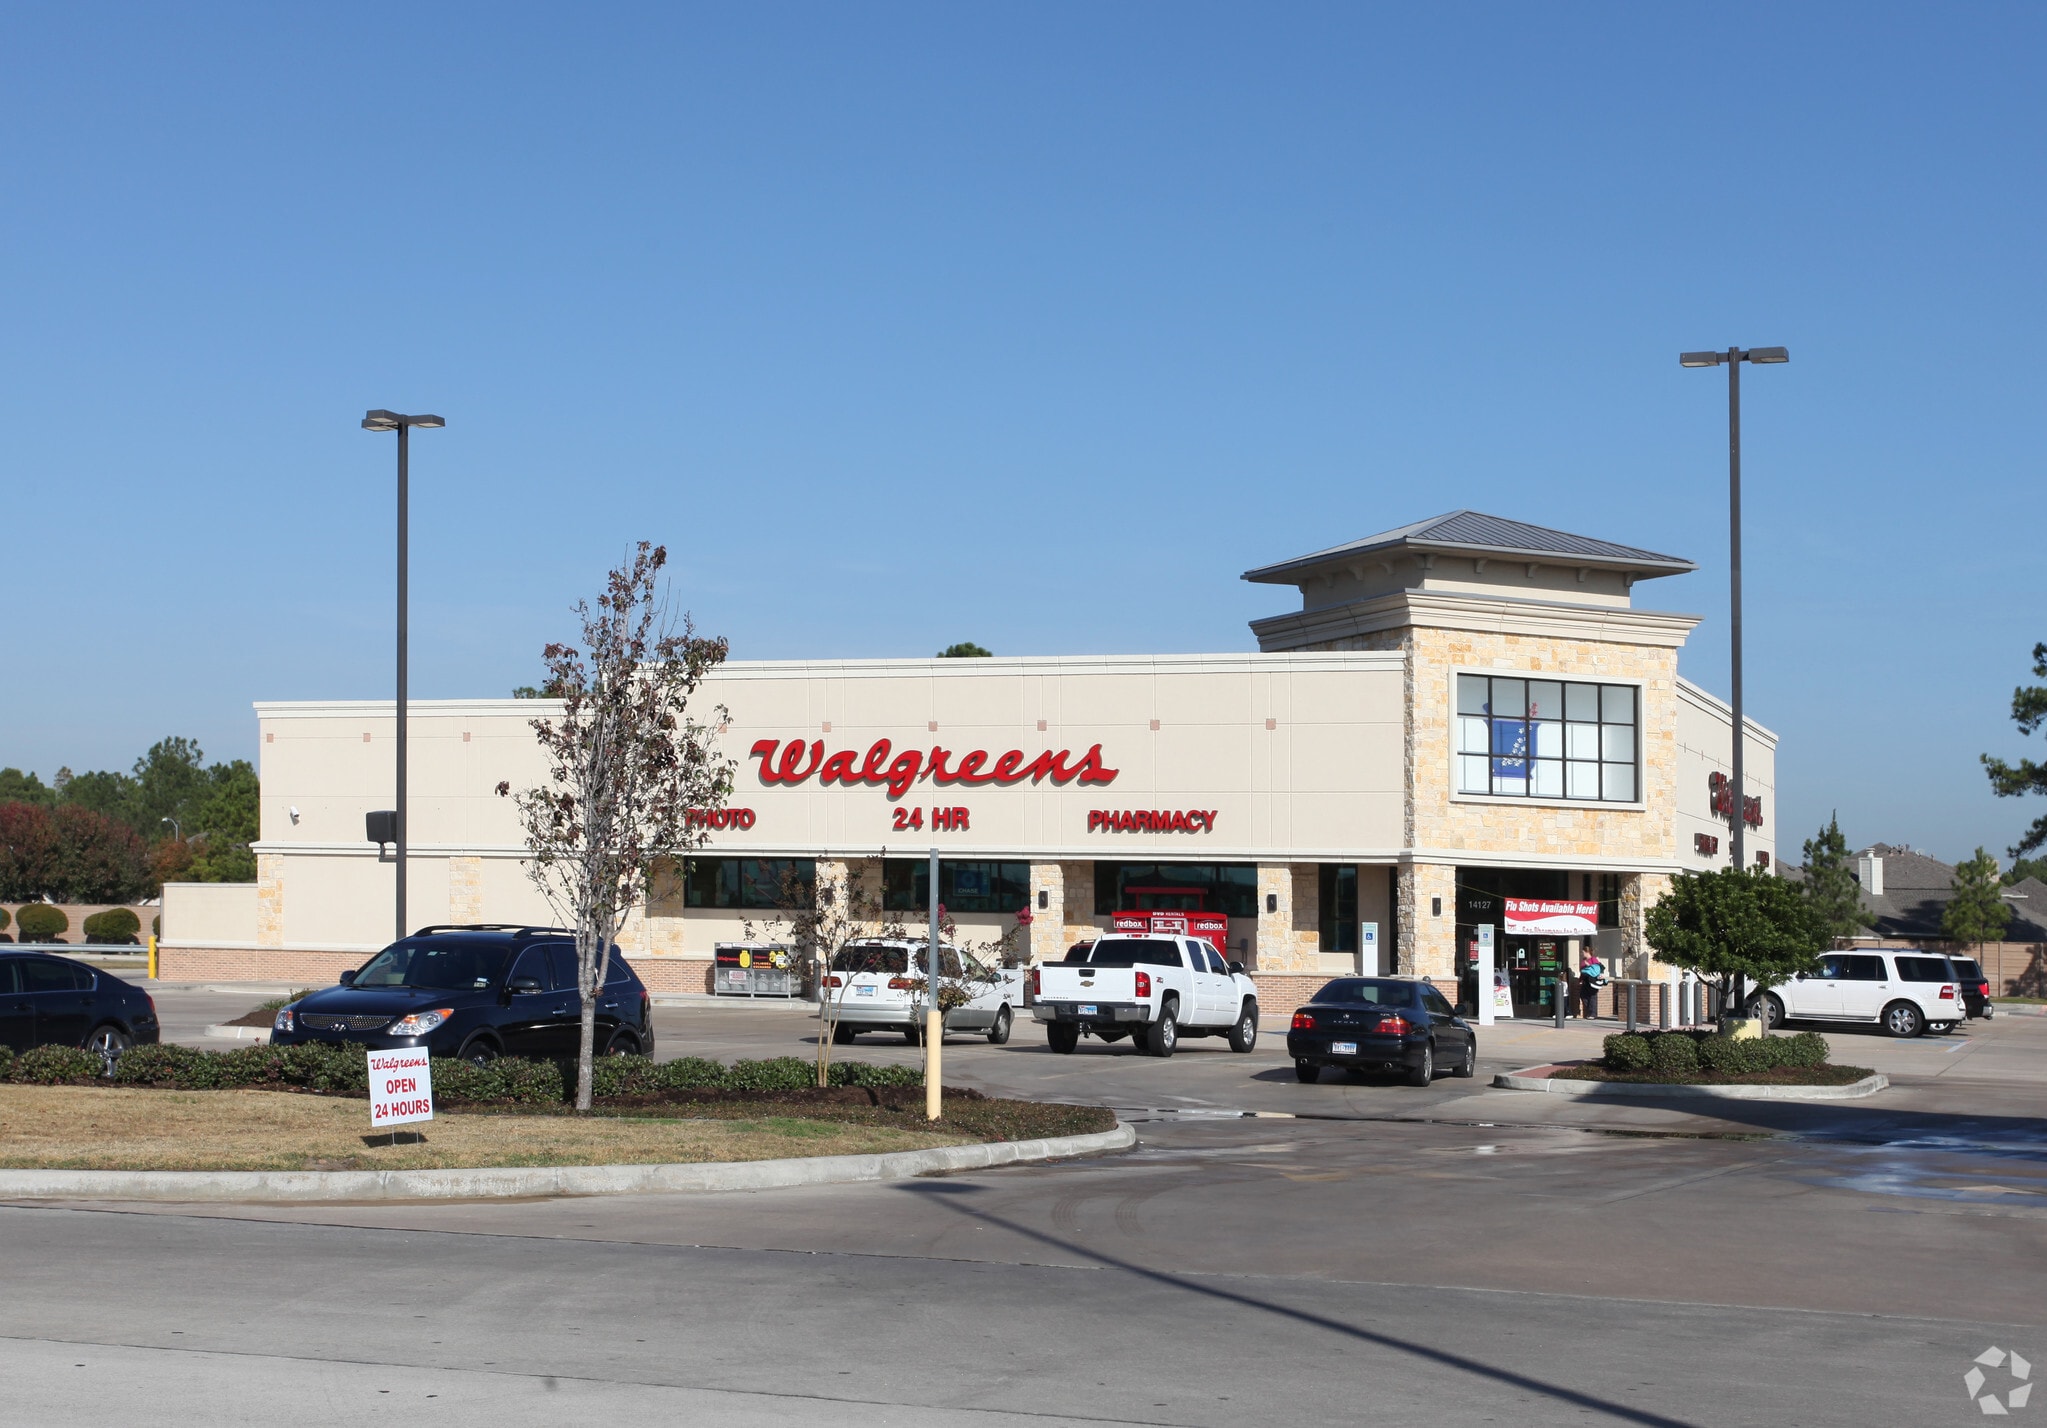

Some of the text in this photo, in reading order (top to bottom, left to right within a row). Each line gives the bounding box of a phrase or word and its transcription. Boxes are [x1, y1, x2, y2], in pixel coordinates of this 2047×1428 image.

[749, 738, 1119, 798] Walgreens
[685, 808, 757, 830] PHOTO
[892, 807, 970, 831] 24 HR
[1088, 810, 1218, 832] PHARMACY
[1468, 901, 1491, 909] 14127
[1505, 900, 1597, 915] Flu Shots Available Here!
[1116, 920, 1143, 928] redbox
[1196, 922, 1224, 930] redbox
[370, 1057, 428, 1073] Walgreens
[386, 1078, 416, 1095] OPEN
[375, 1098, 430, 1119] 24 HOURS
